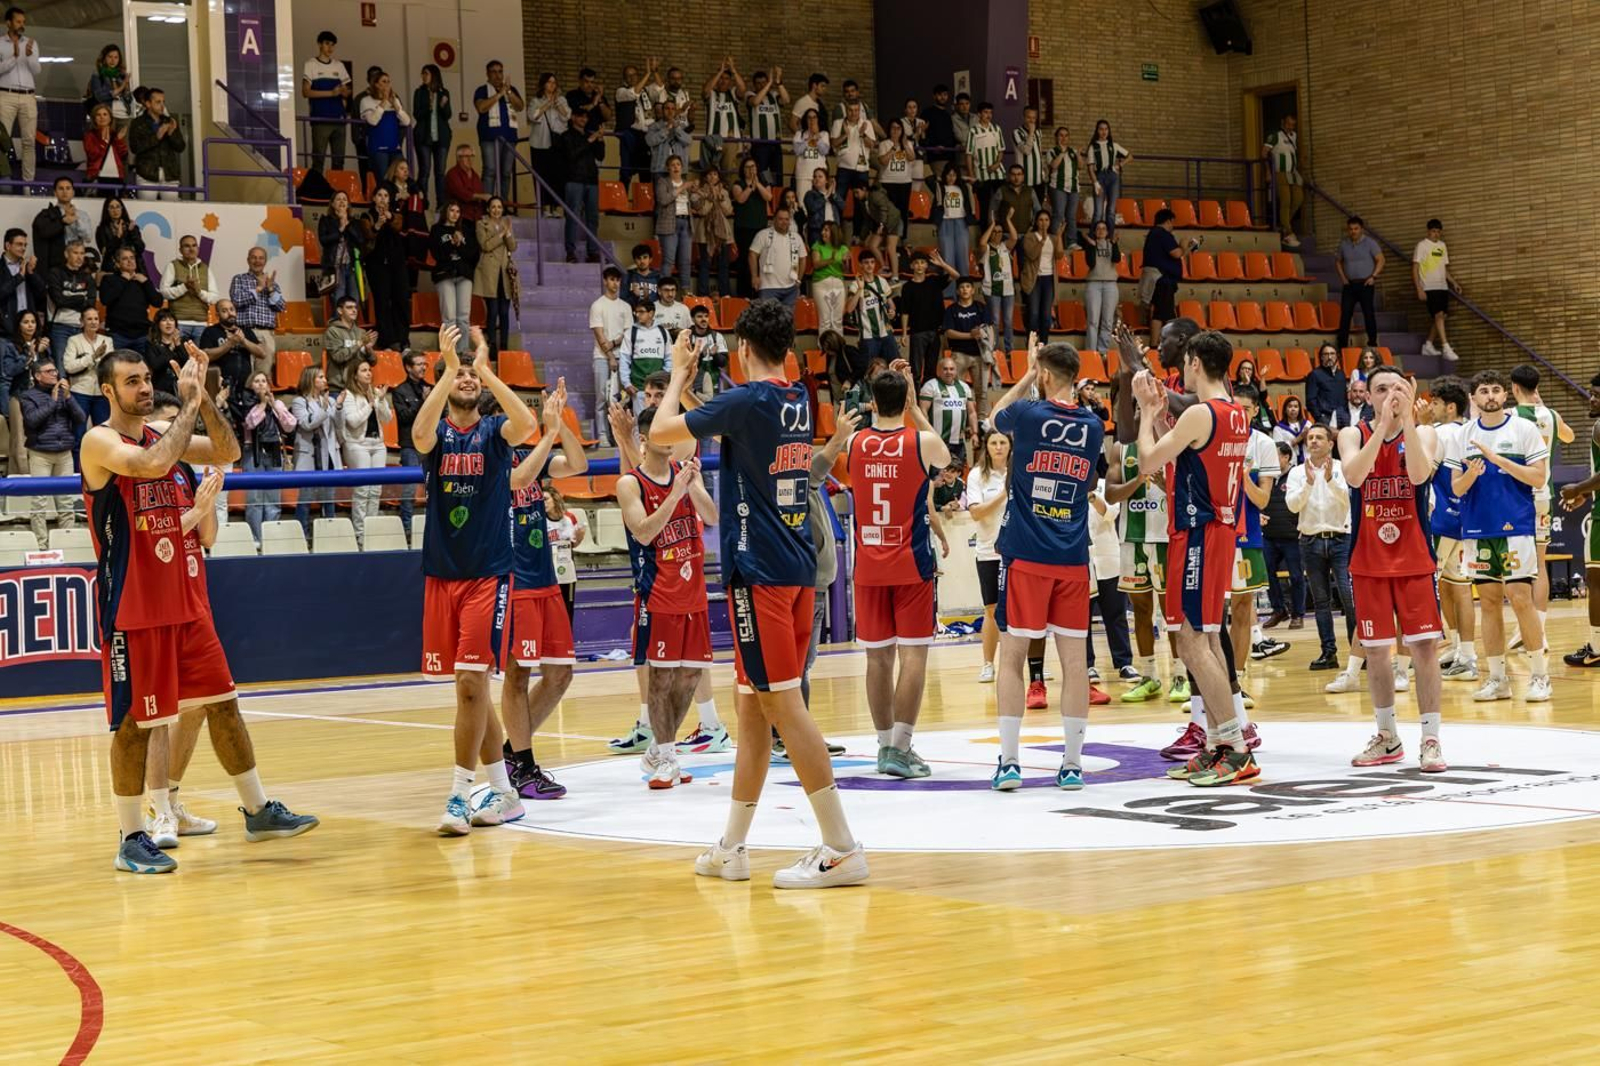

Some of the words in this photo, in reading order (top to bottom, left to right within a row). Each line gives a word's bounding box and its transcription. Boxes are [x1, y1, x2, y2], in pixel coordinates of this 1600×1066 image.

[241, 28, 260, 55] A
[1005, 77, 1018, 100] A
[890, 161, 906, 171] CCB
[306, 338, 320, 347] 26
[865, 462, 898, 478] CAÑETE
[872, 482, 891, 525] 5
[1130, 500, 1158, 510] coto
[1376, 503, 1404, 518] Jaén
[148, 513, 174, 530] Jaén
[1186, 546, 1197, 590] ICLIMB
[734, 588, 749, 643] ICLIMB
[1361, 620, 1373, 638] 16
[113, 631, 127, 682] ICLIMB
[522, 640, 536, 657] 24
[657, 641, 665, 659] 2
[426, 652, 442, 672] 25
[143, 694, 157, 717] 13
